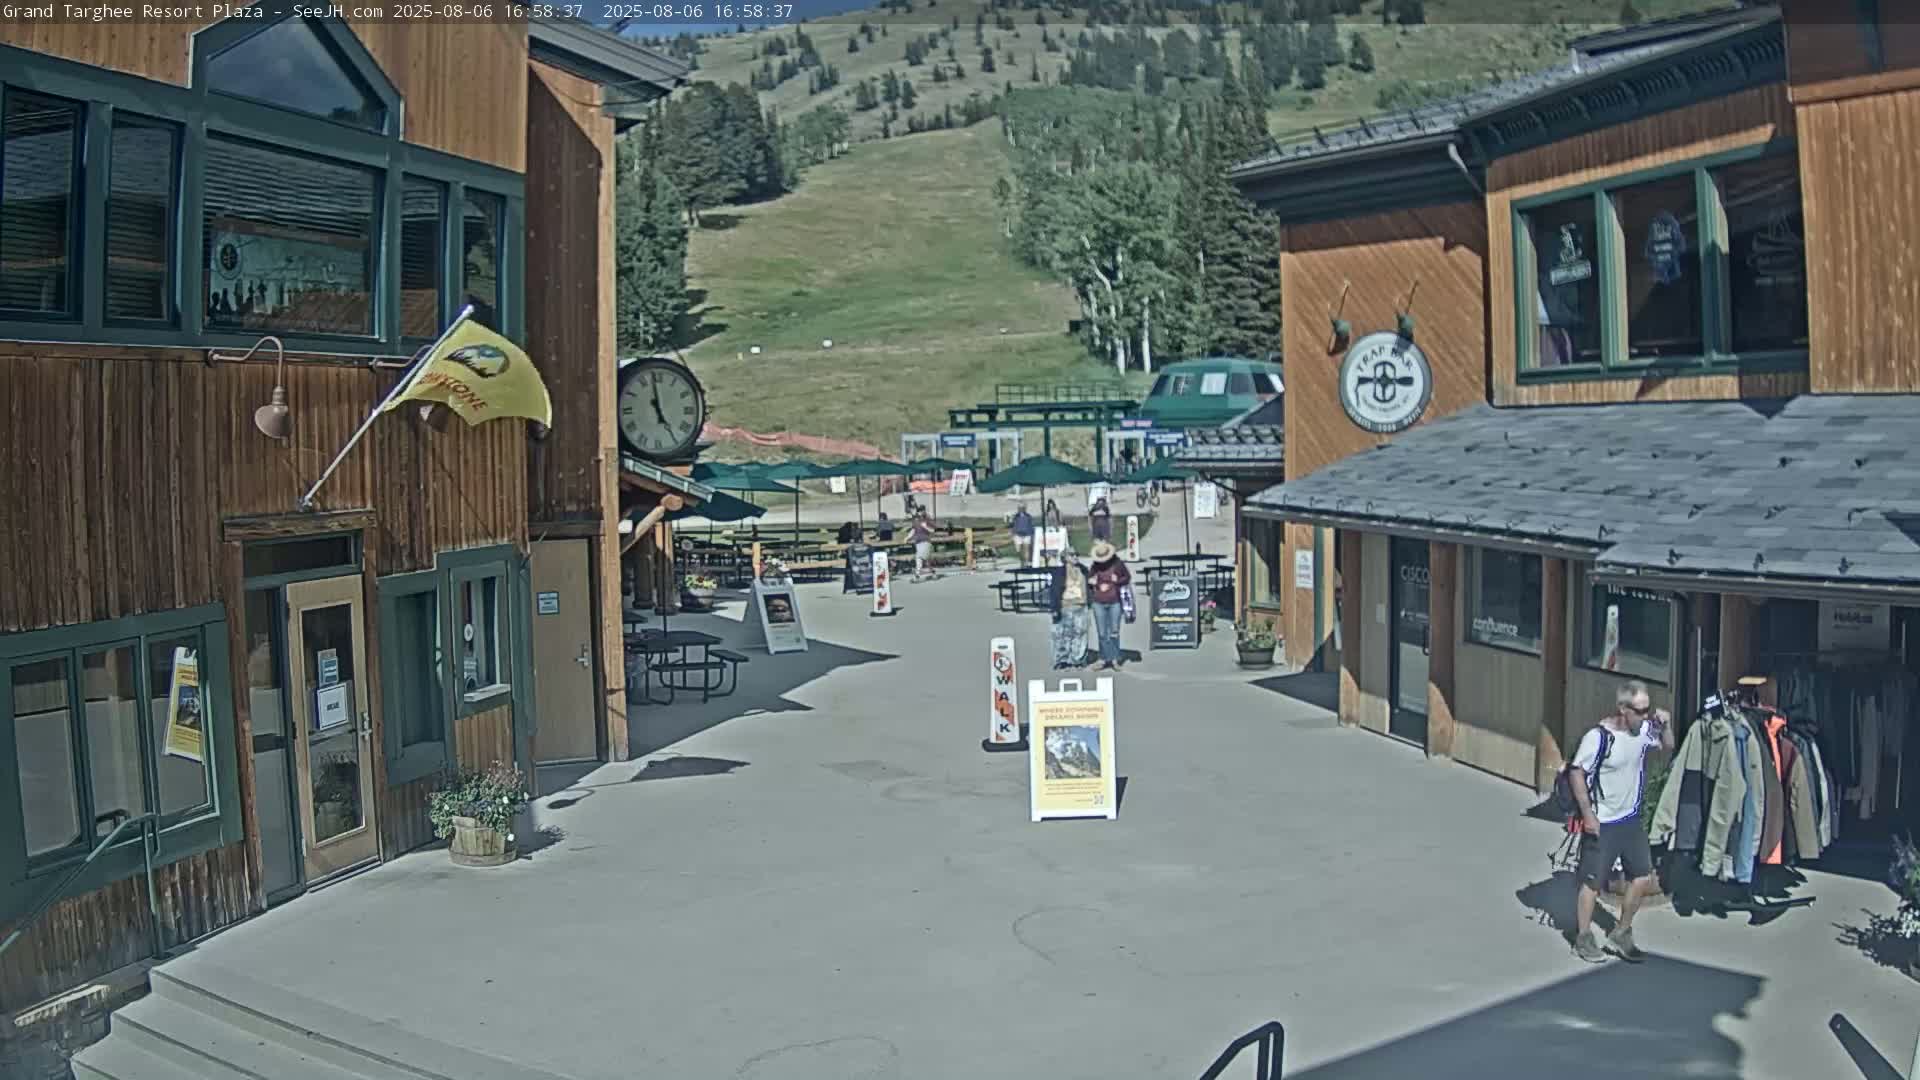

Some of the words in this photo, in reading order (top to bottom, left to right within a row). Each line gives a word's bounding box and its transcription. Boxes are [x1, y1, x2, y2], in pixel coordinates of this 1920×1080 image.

[1356, 345, 1385, 373] TRAP
[416, 371, 488, 411] COME
[1472, 615, 1519, 638] confluence
[996, 675, 1014, 734] WALK
